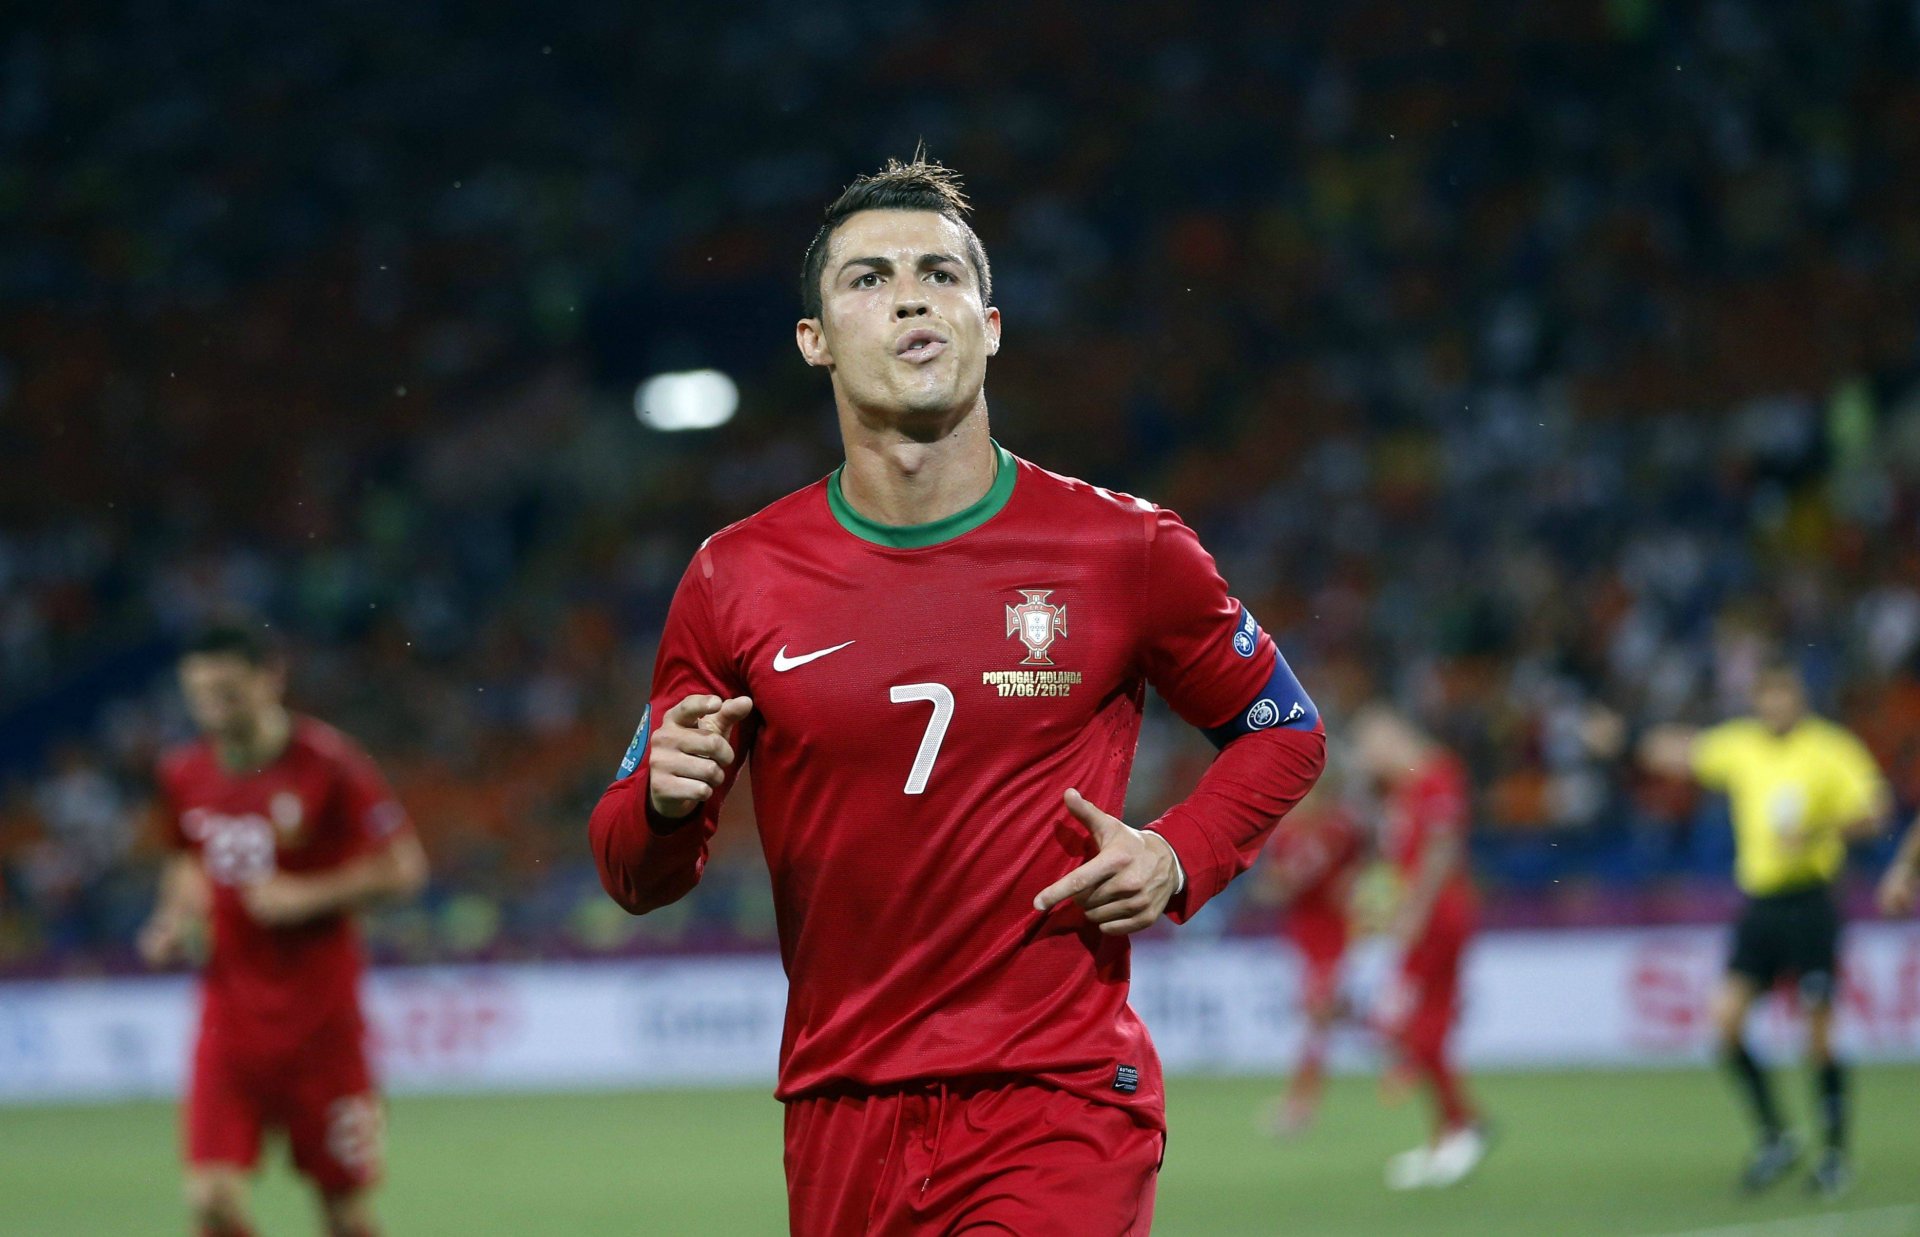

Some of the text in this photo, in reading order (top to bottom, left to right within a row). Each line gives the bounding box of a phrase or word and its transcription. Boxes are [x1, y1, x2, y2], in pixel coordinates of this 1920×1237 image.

[982, 671, 1082, 685] PORTUGAL/HOLANDA
[997, 684, 1070, 697] 17/06/2012
[890, 682, 955, 795] 7
